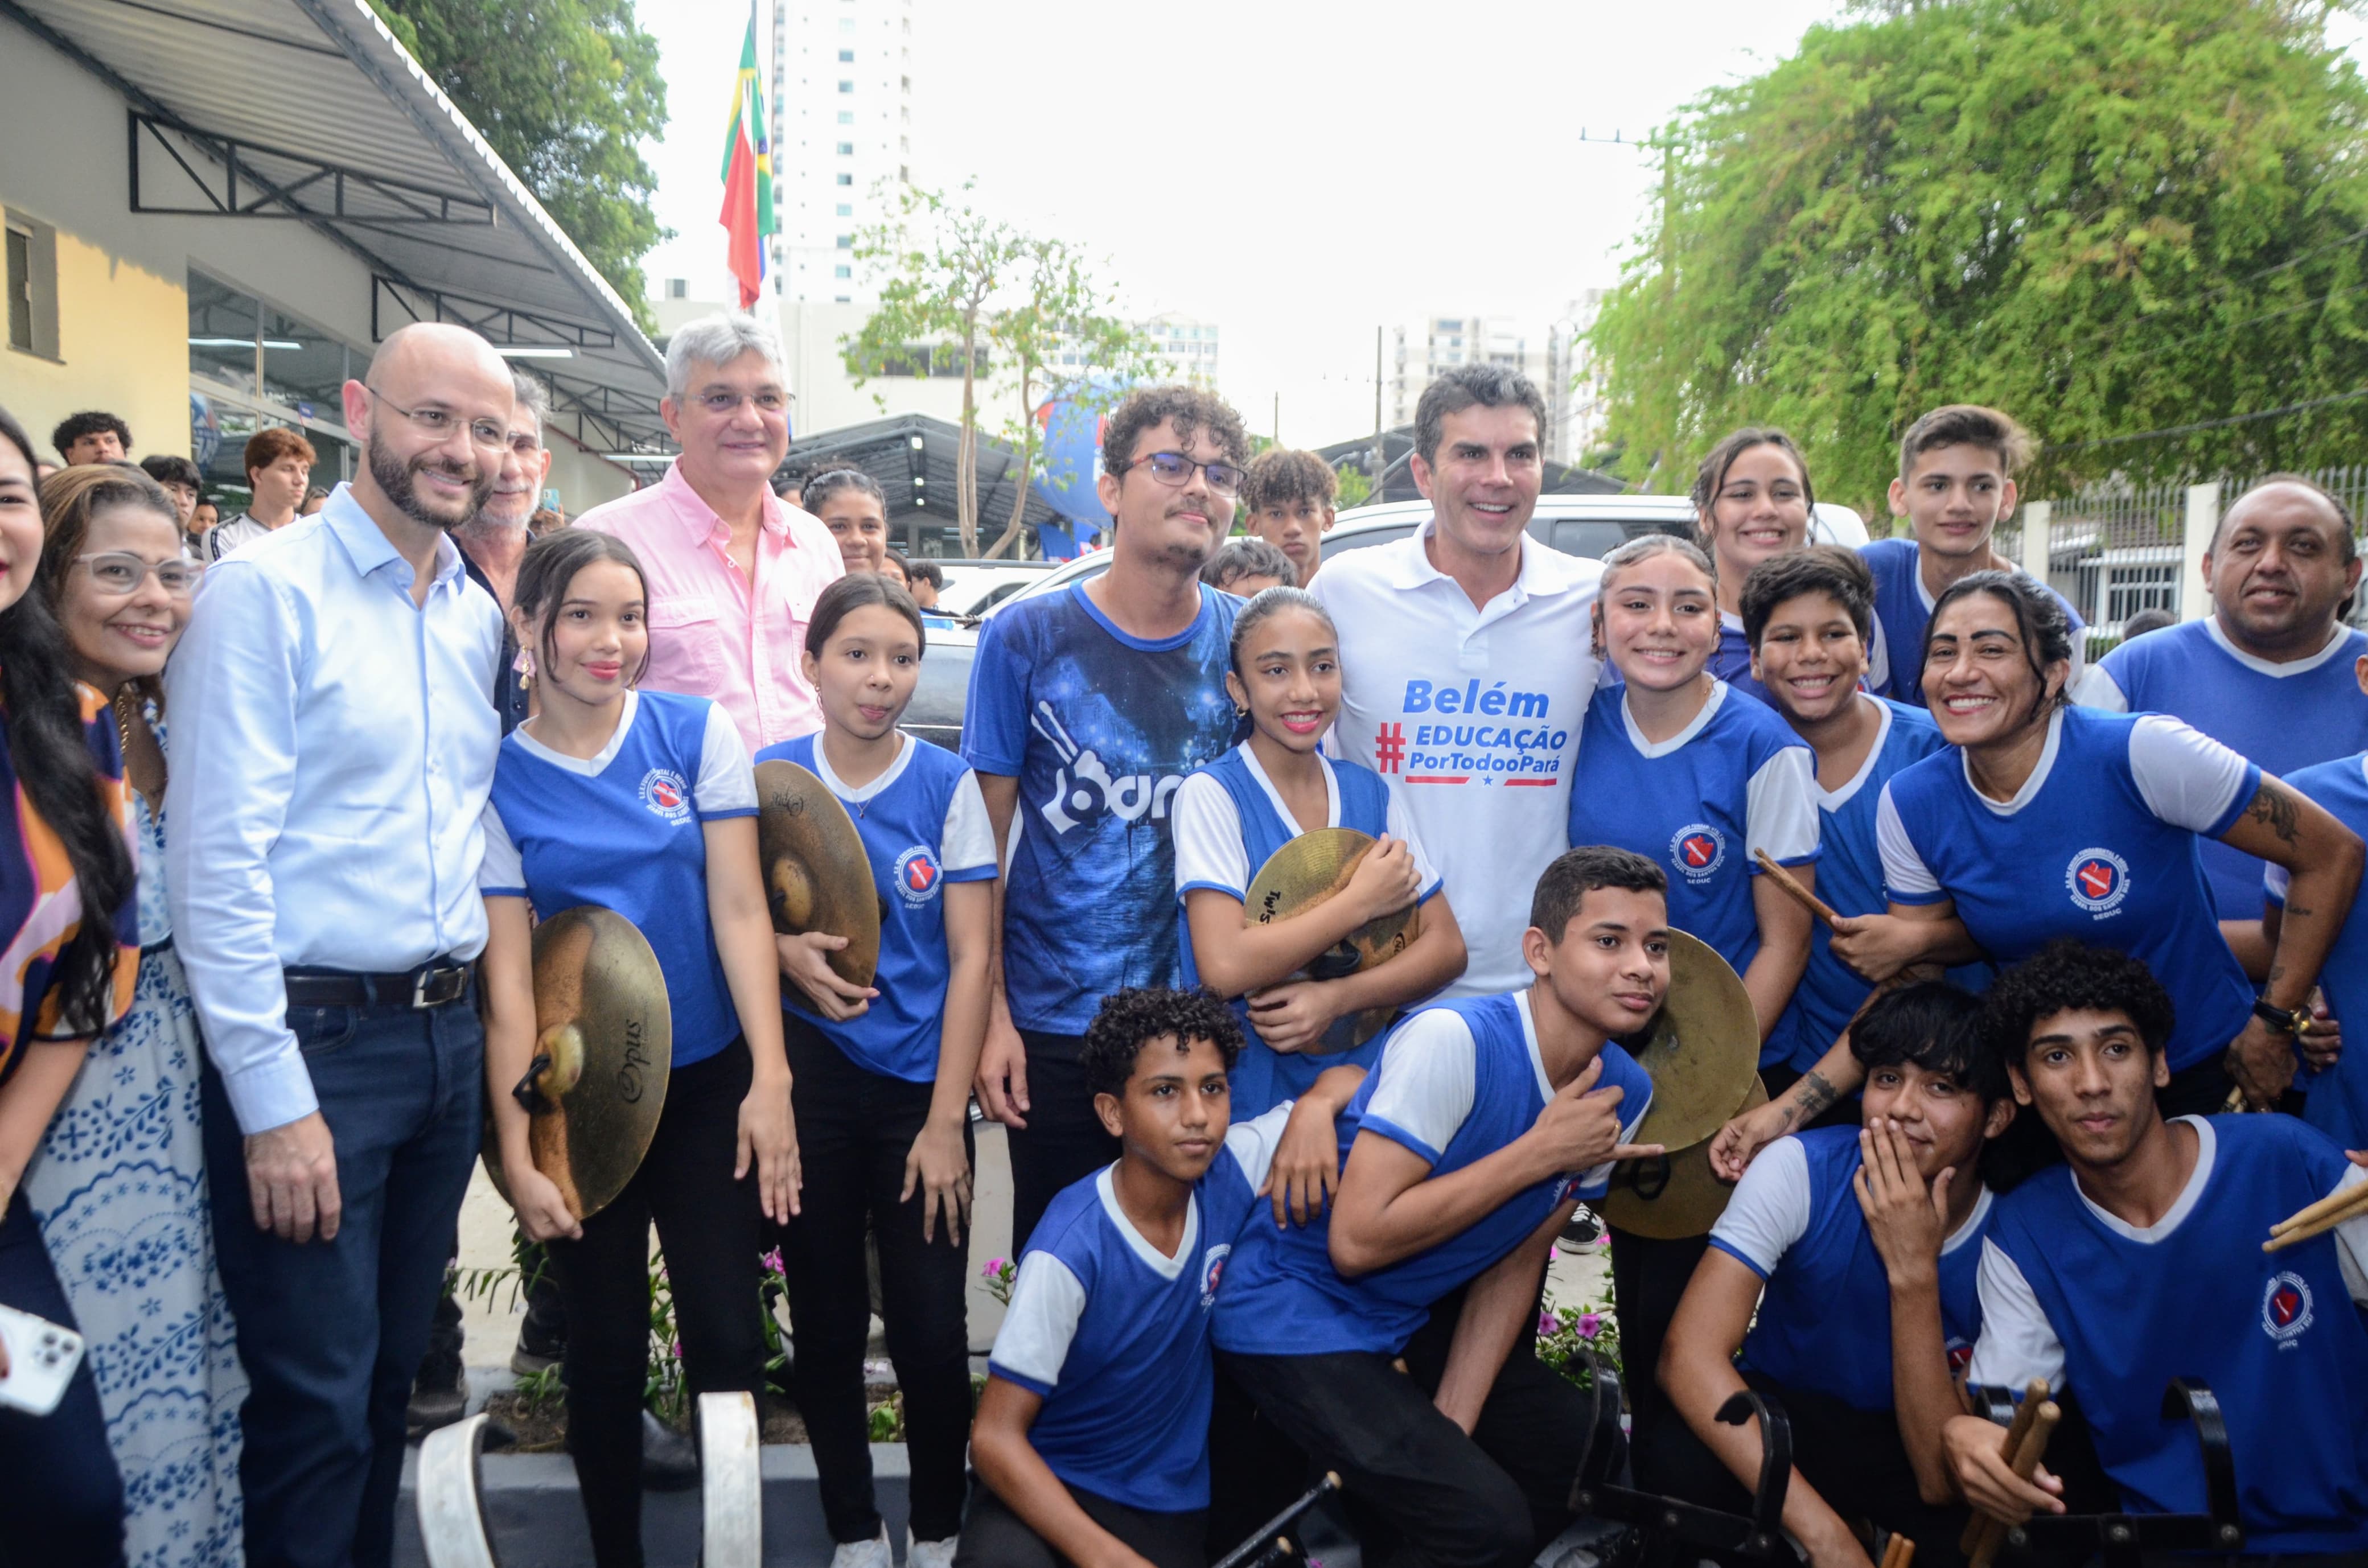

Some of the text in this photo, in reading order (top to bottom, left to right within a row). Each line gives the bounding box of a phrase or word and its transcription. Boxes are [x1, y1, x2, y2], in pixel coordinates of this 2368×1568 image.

[1402, 678, 1549, 718] Belém
[1415, 725, 1568, 755] EDUCAÇÃO
[1409, 752, 1560, 773] PorTodooPará
[1697, 866, 1717, 878] SANTOS
[2093, 908, 2122, 920] SEDUC
[619, 1019, 651, 1104] Opus
